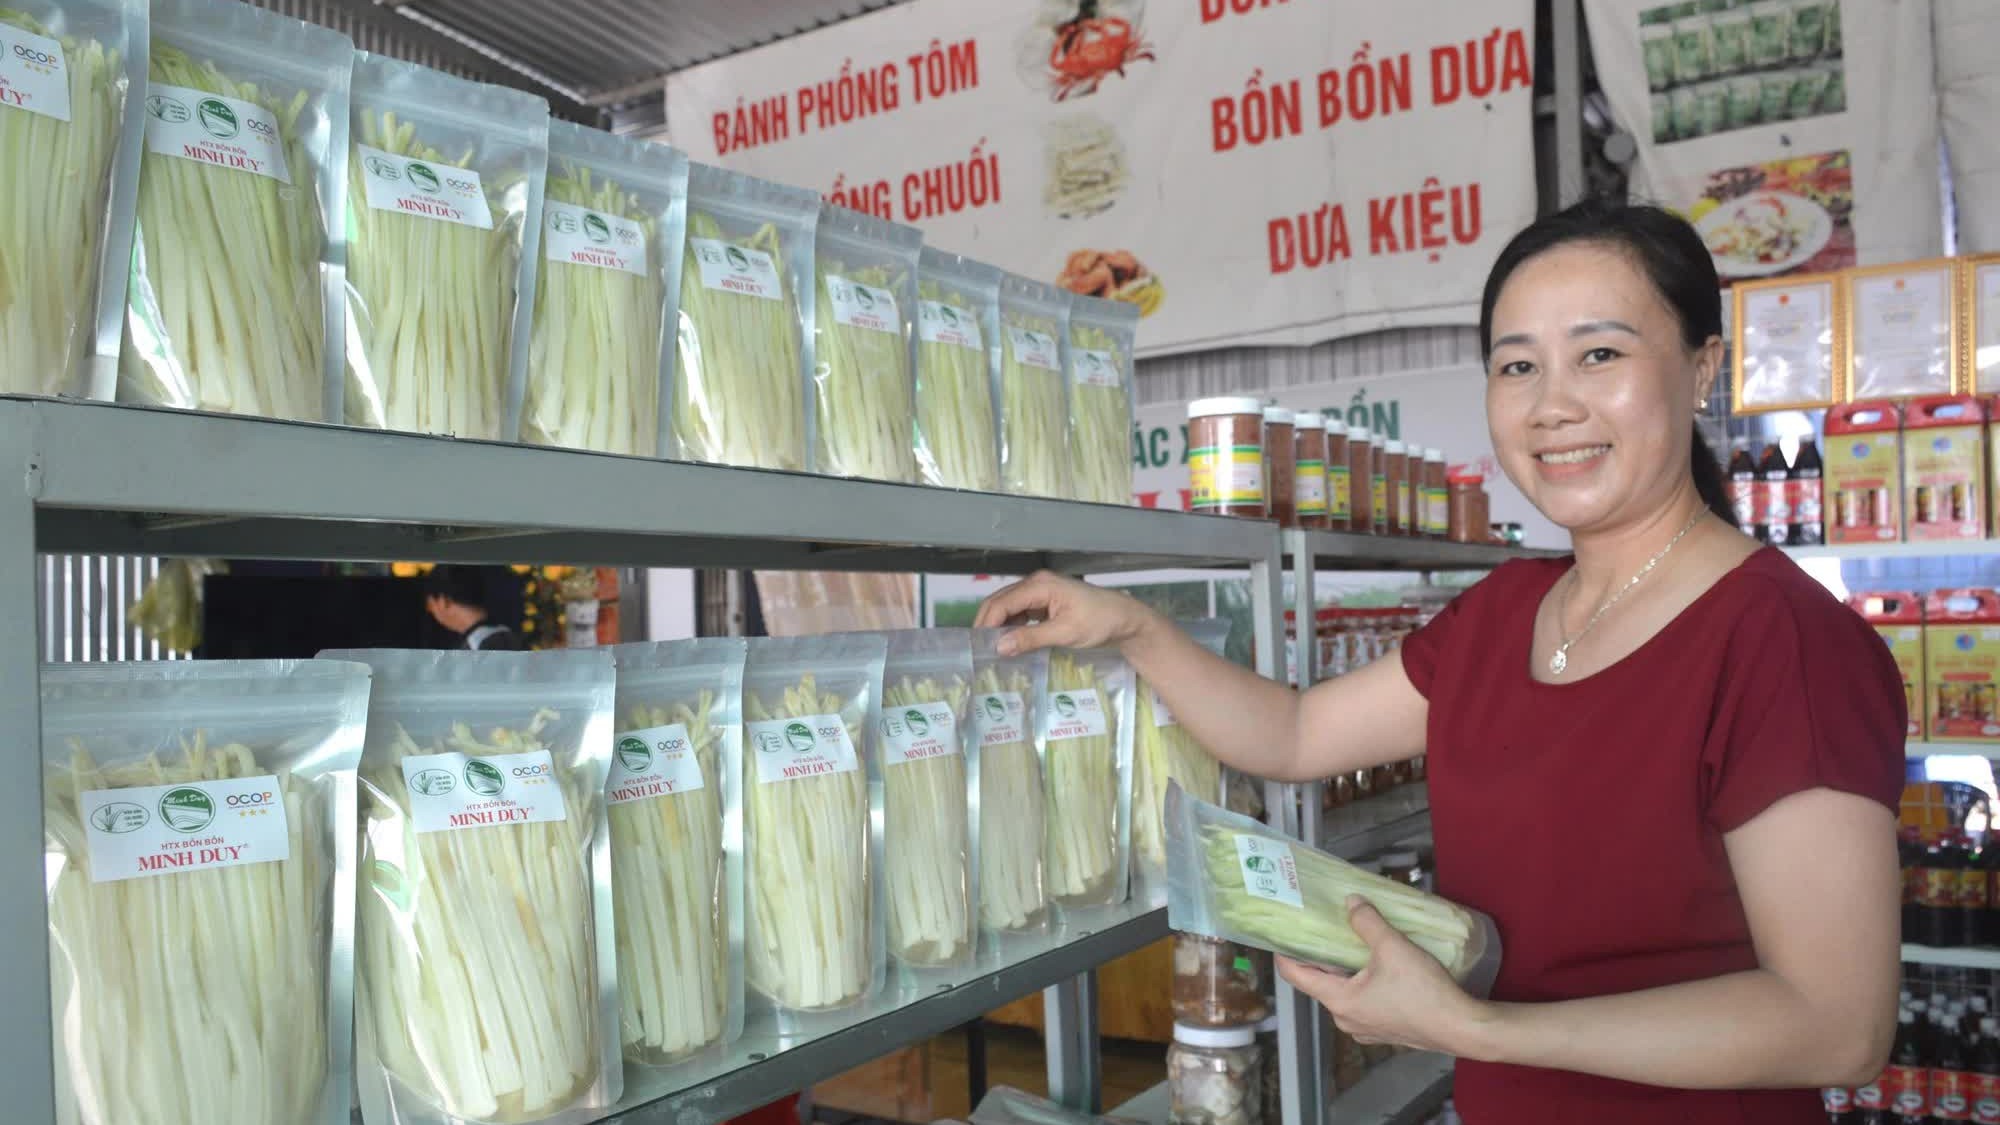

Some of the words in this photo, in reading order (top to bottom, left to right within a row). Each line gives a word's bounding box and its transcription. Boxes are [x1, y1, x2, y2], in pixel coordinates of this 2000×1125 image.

[14, 44, 57, 65] OCOP
[712, 95, 789, 156] BÁNH
[907, 38, 979, 103] TÔM
[1210, 67, 1302, 152] BỒN
[1317, 41, 1412, 128] BỒN
[1430, 26, 1533, 107] DƯA
[183, 144, 225, 165] MINH
[229, 155, 261, 172] DUY
[903, 136, 1001, 222] CHUỐI
[396, 197, 432, 217] MINH
[1267, 201, 1352, 275] DƯA
[1368, 176, 1482, 264] KIỆU
[512, 763, 549, 777] OCOP
[226, 792, 272, 806] OCOP
[611, 785, 646, 801] MINH
[648, 780, 673, 795] DUY
[449, 811, 494, 827] MINH
[498, 807, 530, 822] DUY
[161, 842, 181, 850] HTX
[138, 851, 194, 872] MINH
[199, 846, 241, 864] DUY
